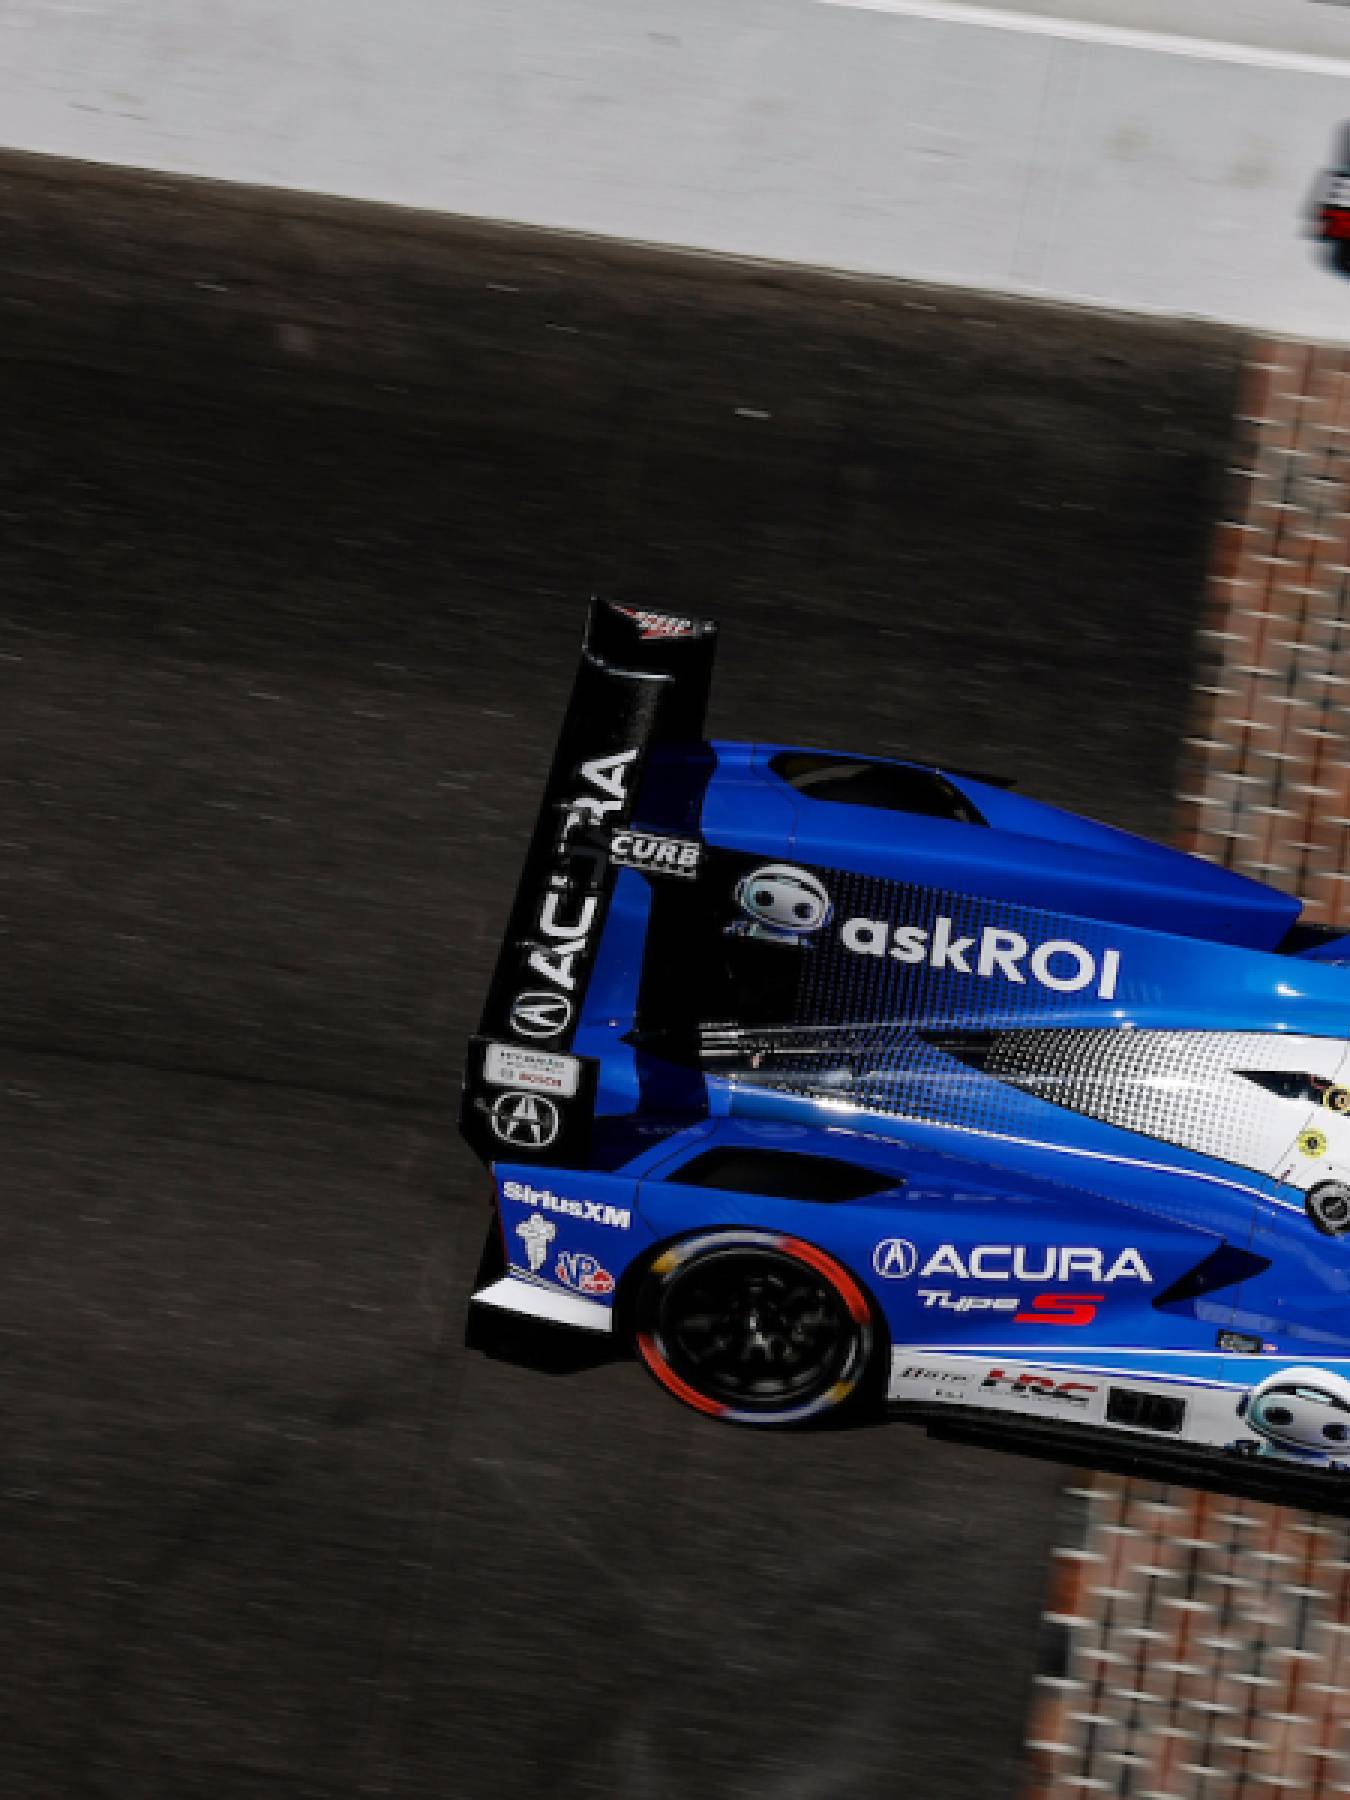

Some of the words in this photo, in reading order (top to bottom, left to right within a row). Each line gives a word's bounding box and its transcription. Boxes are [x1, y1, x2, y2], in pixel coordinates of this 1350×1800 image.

[527, 748, 640, 990] ACRA
[612, 833, 700, 866] CURB
[841, 917, 1121, 1000] askROI
[503, 1181, 632, 1231] SiriusXM
[919, 1244, 1154, 1283] ACURA
[917, 1289, 1020, 1312] Type
[1013, 1294, 1105, 1326] S
[979, 1367, 1099, 1402] HRC
